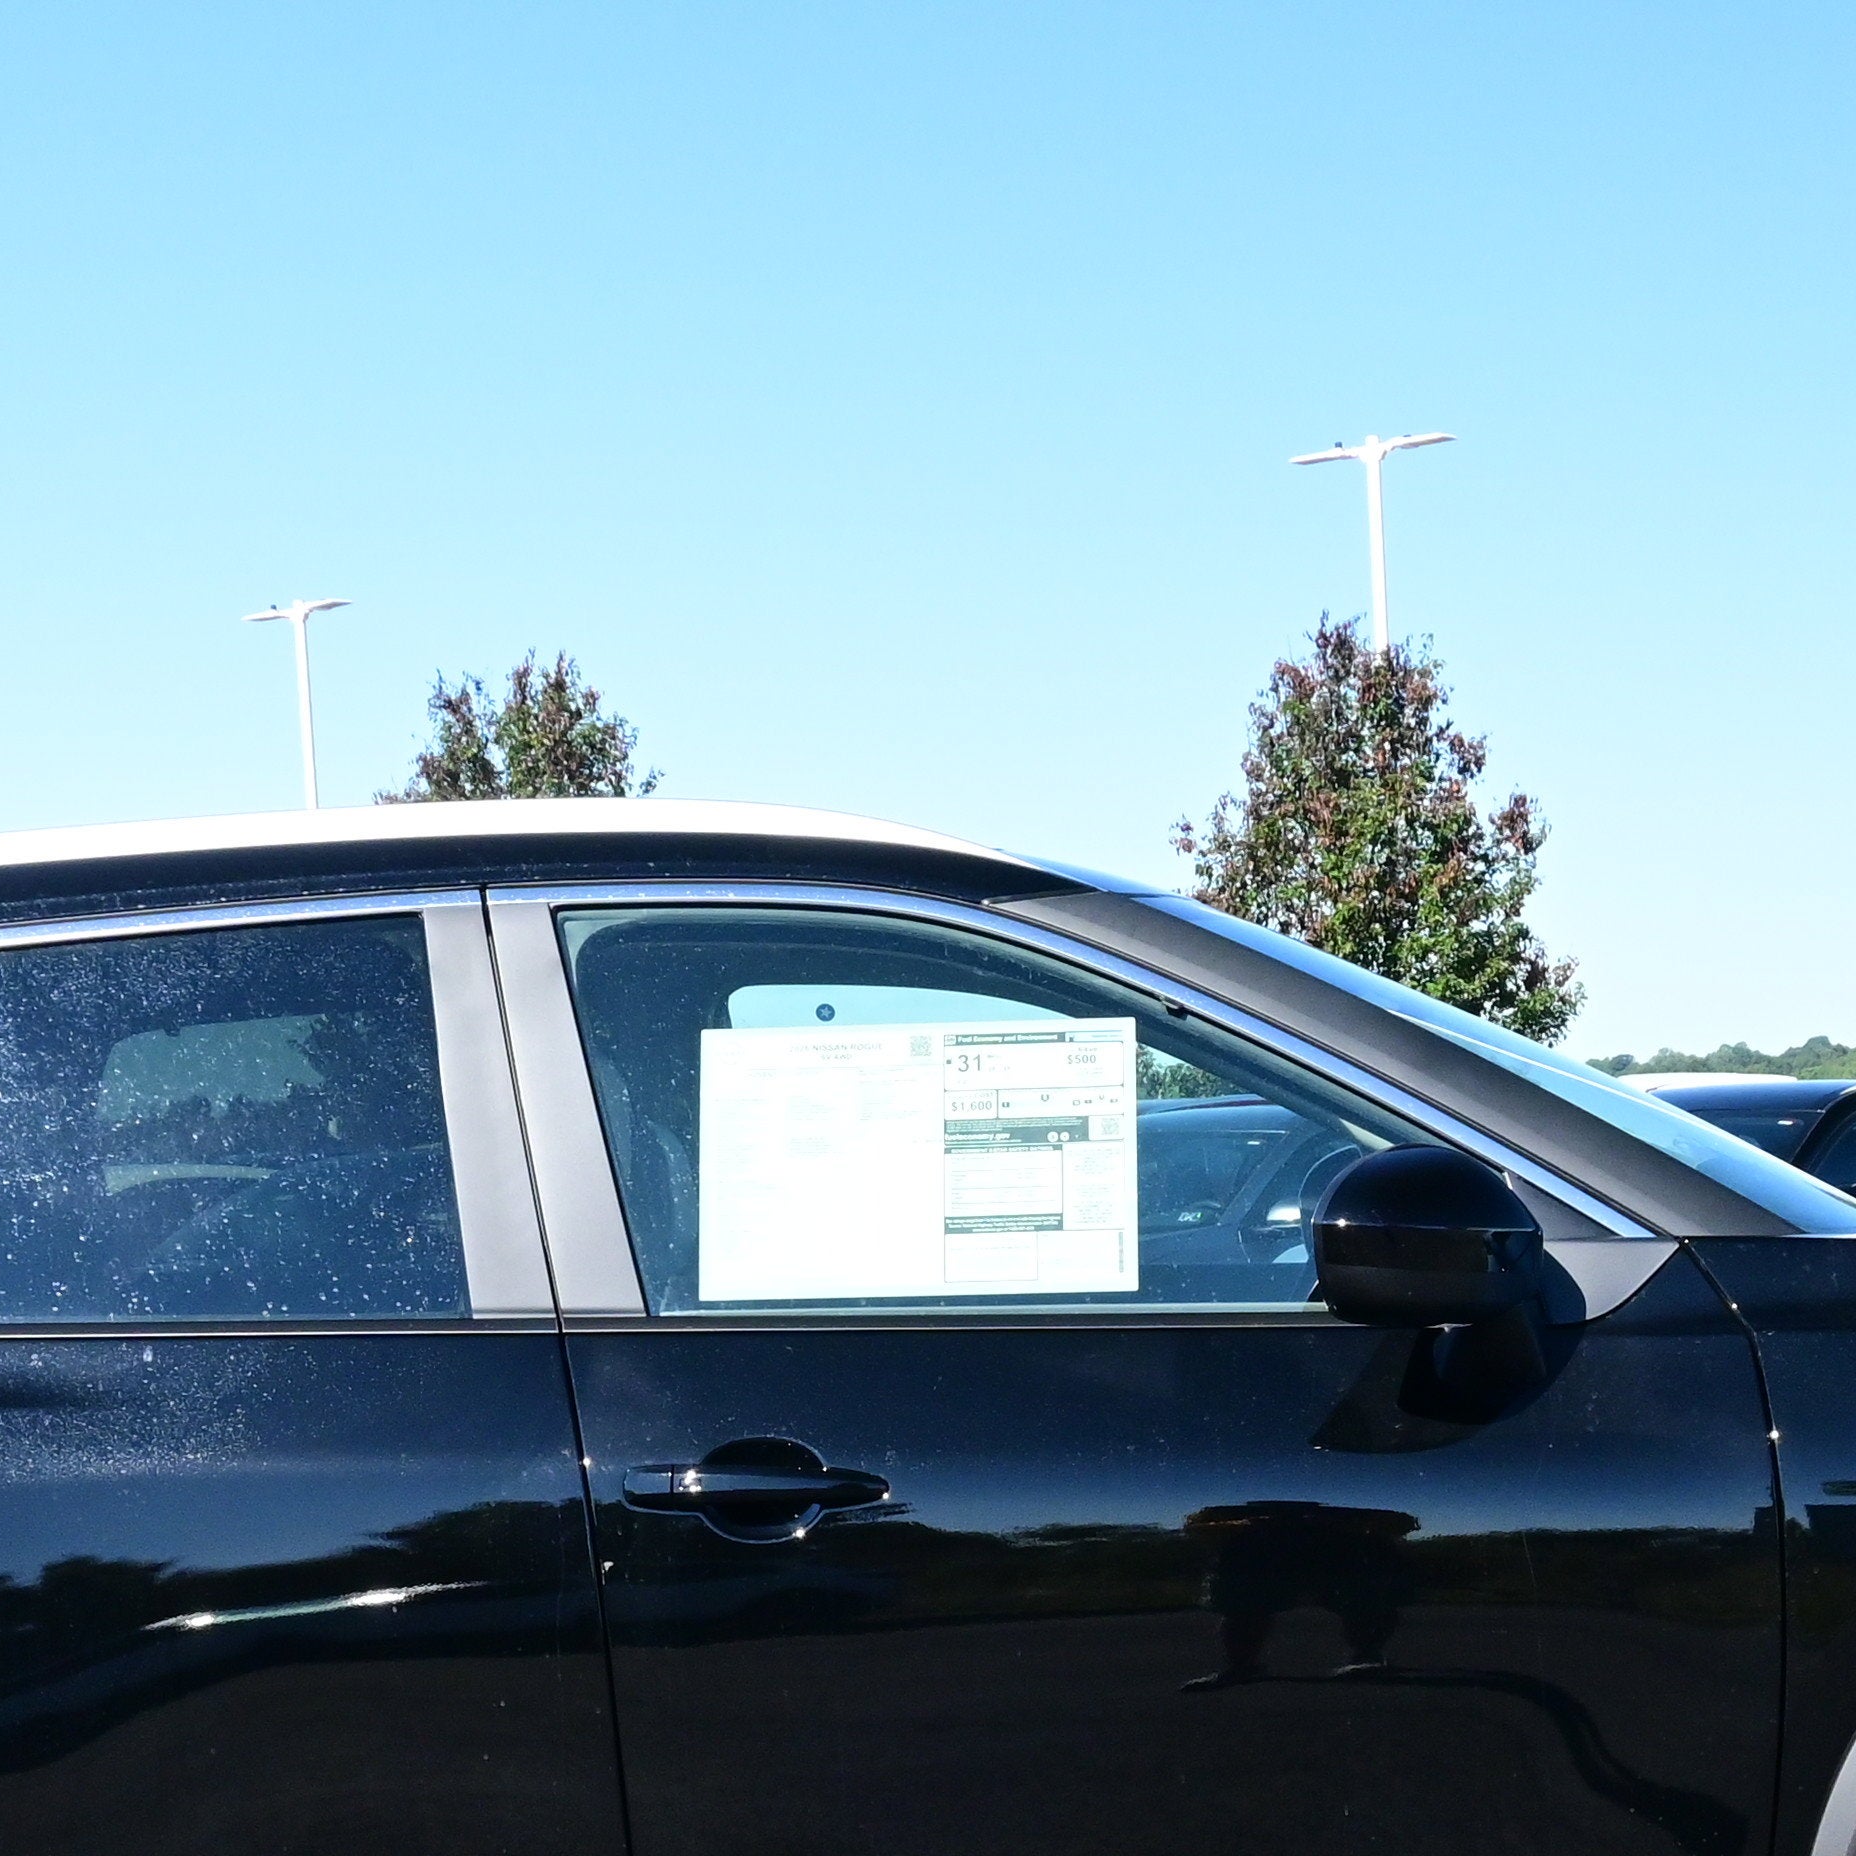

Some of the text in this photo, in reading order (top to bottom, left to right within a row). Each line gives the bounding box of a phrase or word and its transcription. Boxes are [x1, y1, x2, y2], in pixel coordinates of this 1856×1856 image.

[957, 1054, 981, 1072] 31
[1067, 1054, 1097, 1065] $500
[951, 1100, 993, 1113] $1,600
